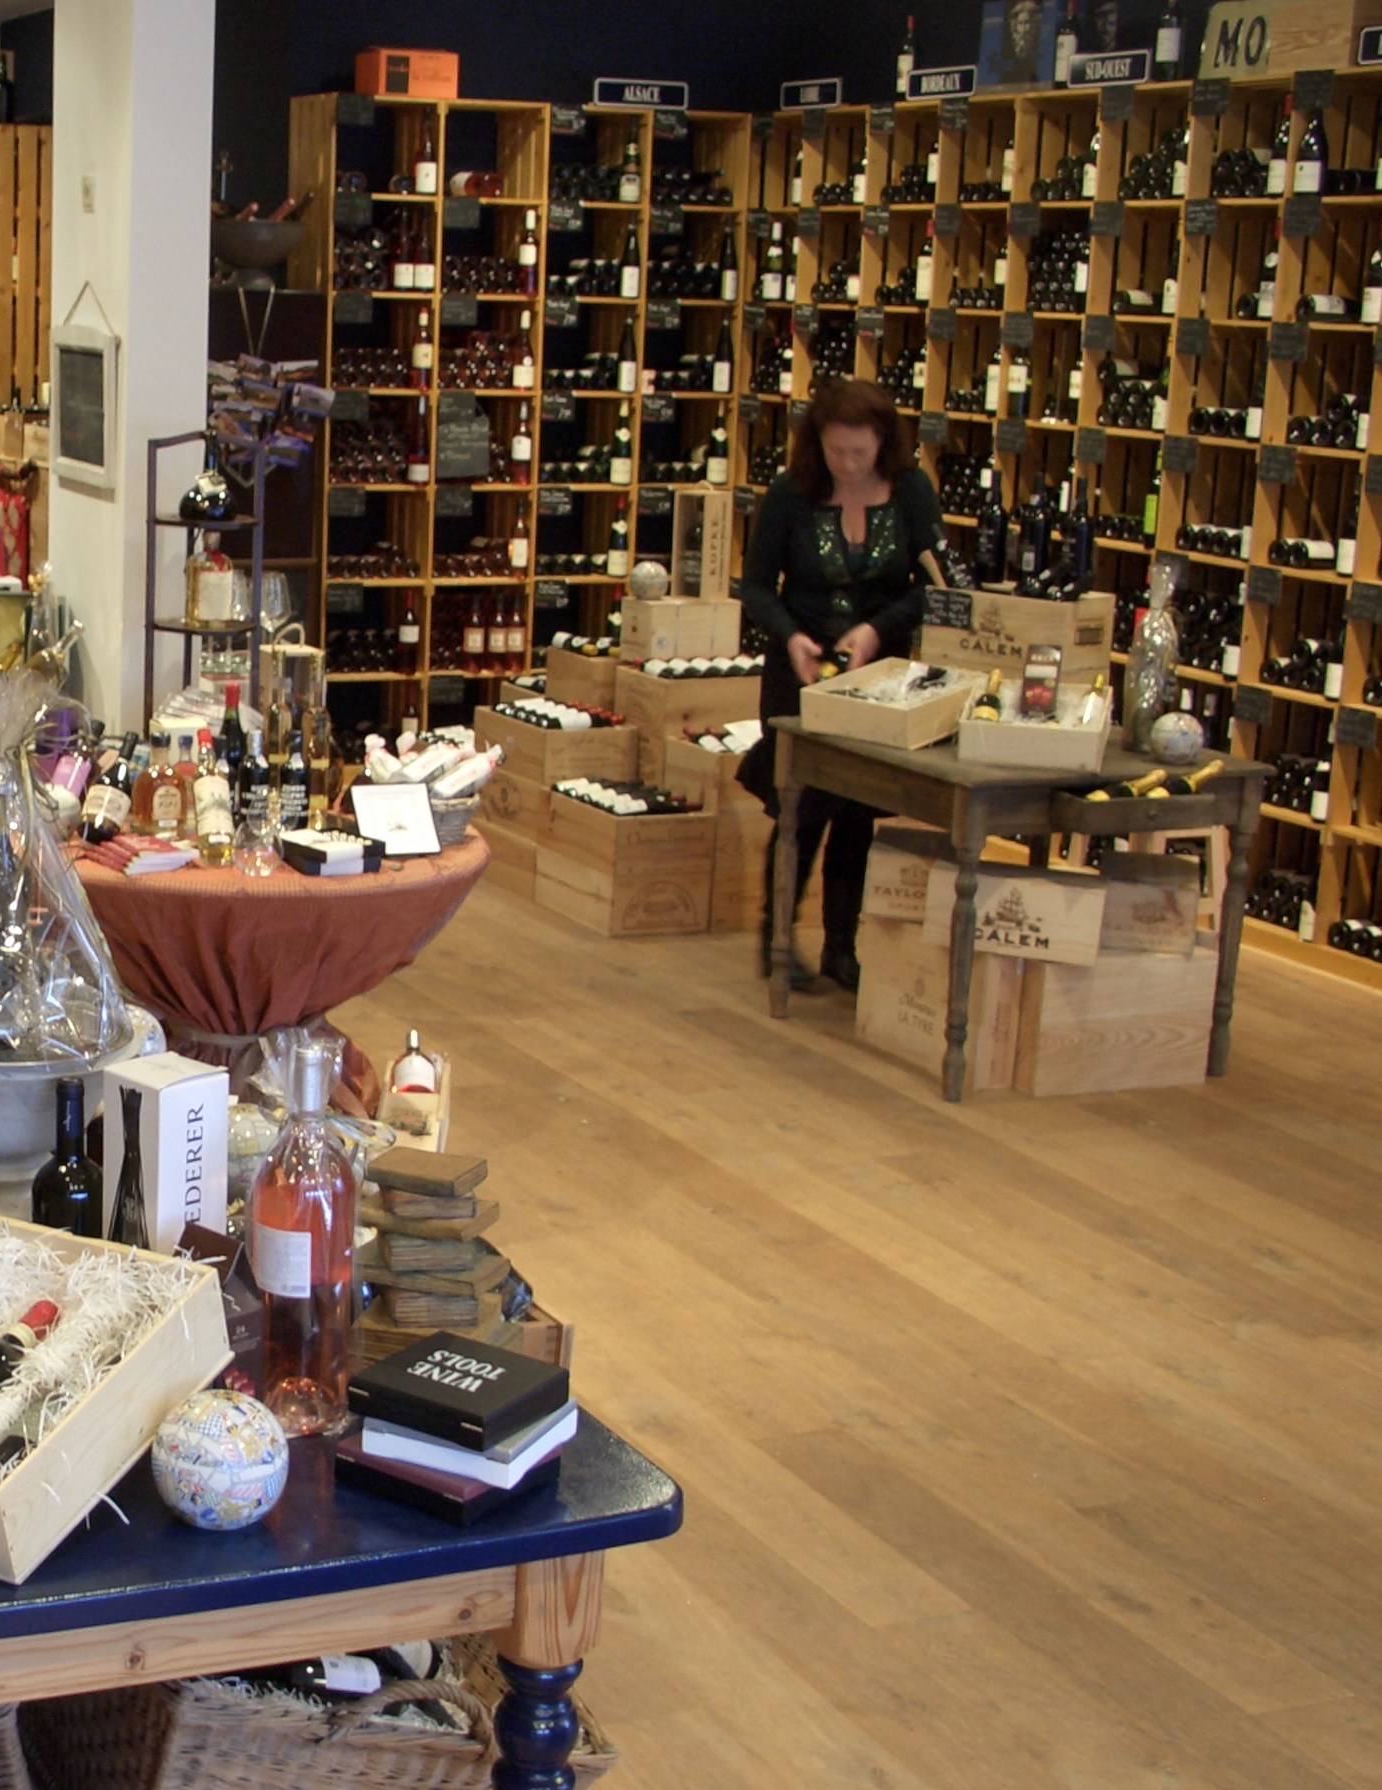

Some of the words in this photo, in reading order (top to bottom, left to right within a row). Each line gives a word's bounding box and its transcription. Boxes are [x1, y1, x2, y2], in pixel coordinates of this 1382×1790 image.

[1213, 16, 1268, 68] MO
[622, 85, 661, 102] ALSACE
[873, 885, 925, 899] TAYLO
[407, 1361, 484, 1393] WINE
[427, 1349, 507, 1381] TOOLS
